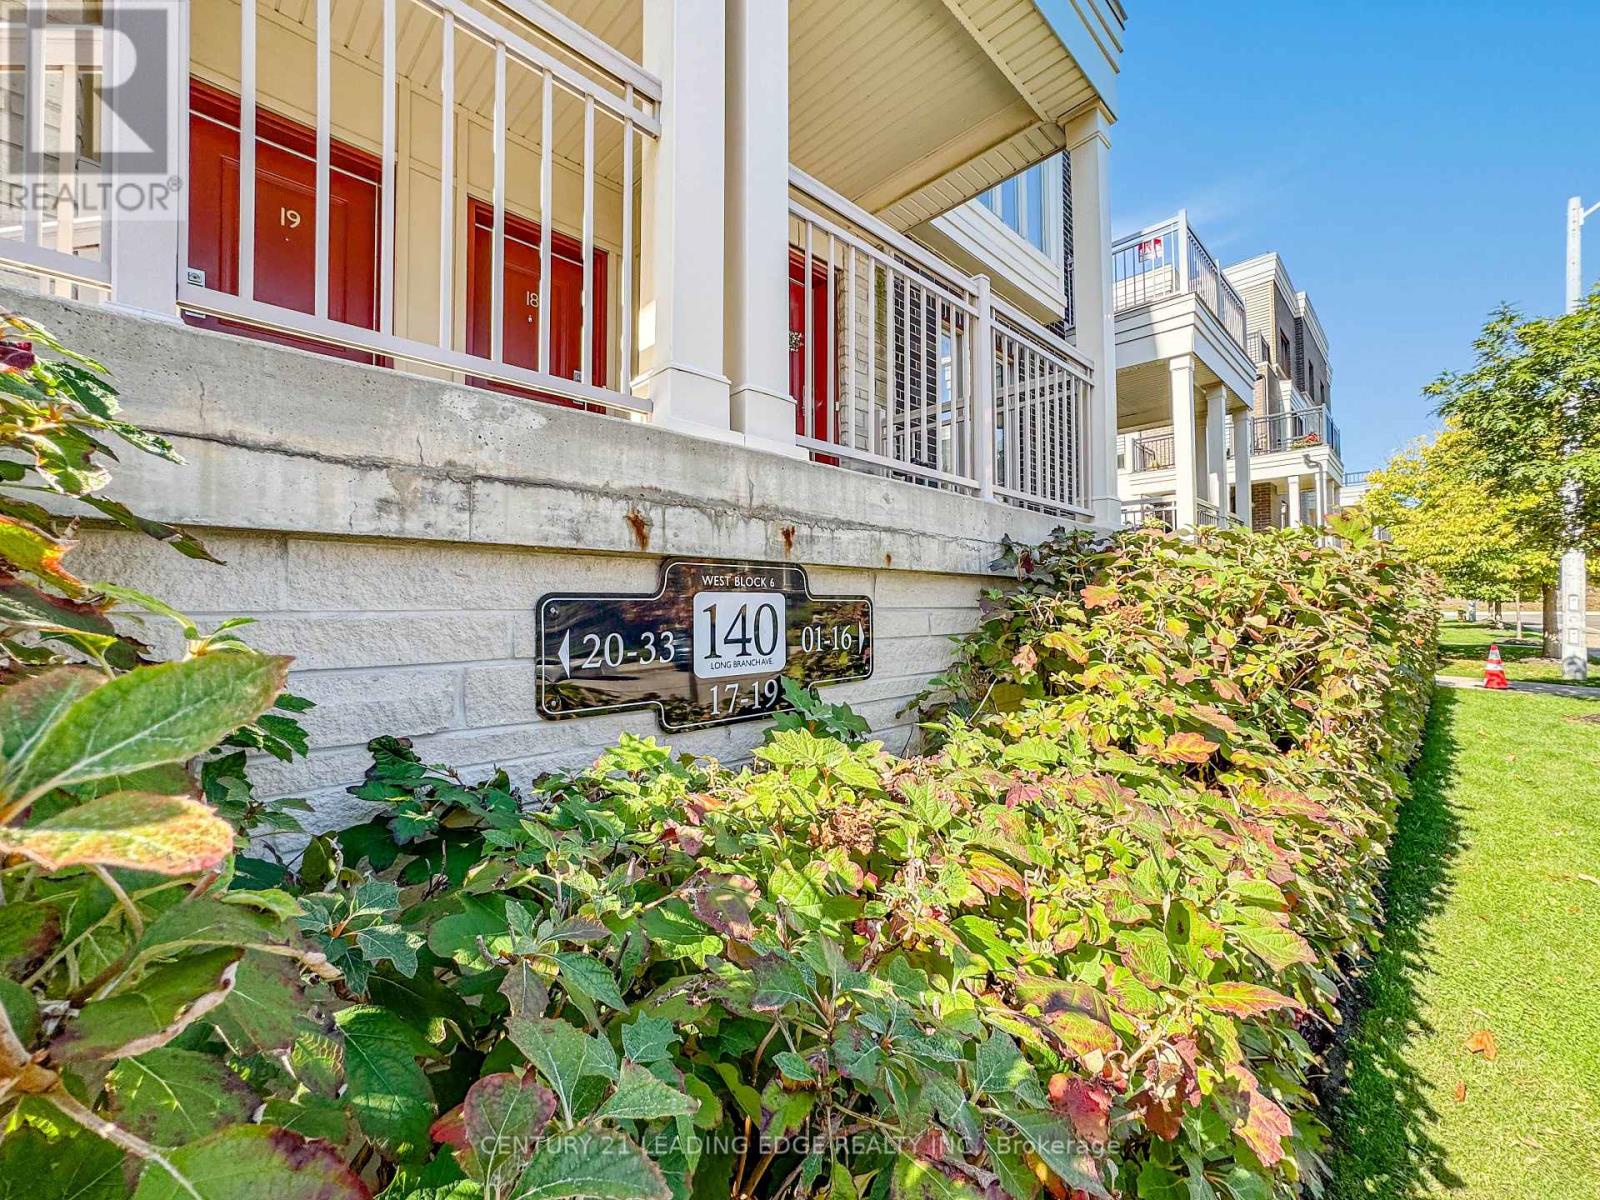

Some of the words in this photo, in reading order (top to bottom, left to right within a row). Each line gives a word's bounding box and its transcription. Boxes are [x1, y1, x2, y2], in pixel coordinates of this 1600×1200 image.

[280, 206, 301, 229] 19
[526, 290, 539, 308] 18
[701, 575, 731, 587] WEST
[734, 576, 767, 588] BLOCK
[769, 577, 775, 588] 6
[702, 602, 778, 660] 140
[801, 625, 852, 653] 01-16
[581, 630, 676, 669] 20-33
[710, 660, 732, 670] LONG
[709, 679, 779, 716] 17-19
